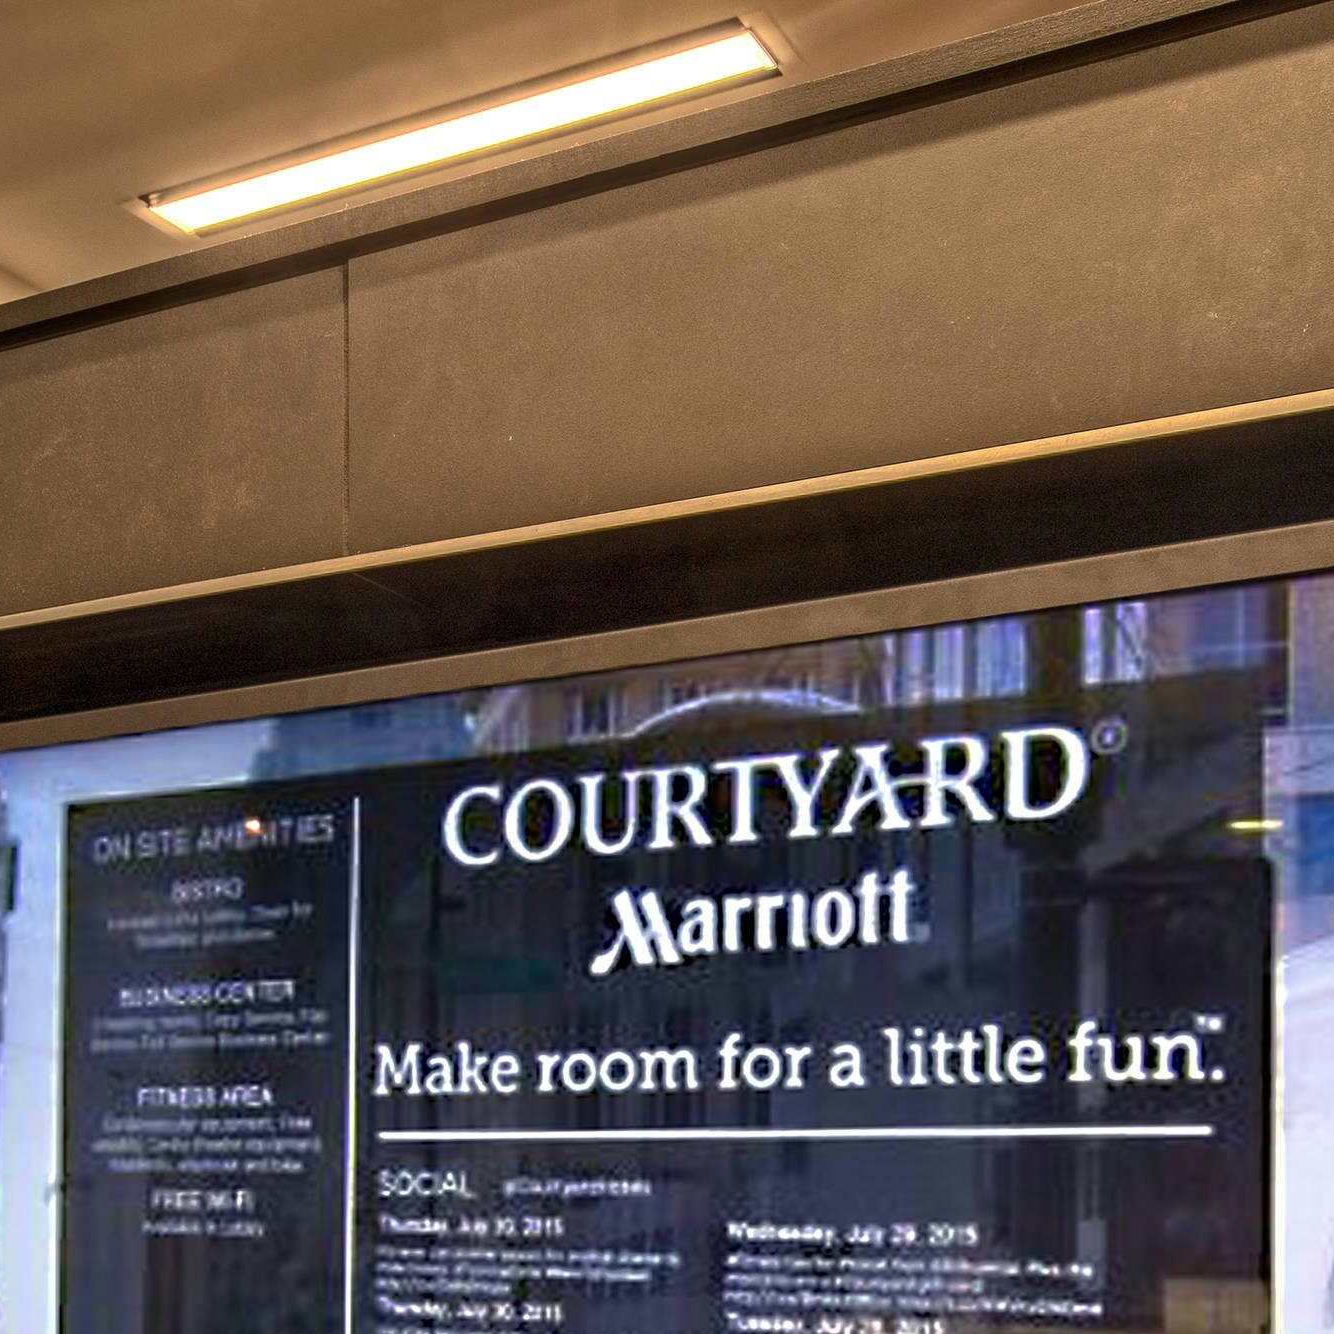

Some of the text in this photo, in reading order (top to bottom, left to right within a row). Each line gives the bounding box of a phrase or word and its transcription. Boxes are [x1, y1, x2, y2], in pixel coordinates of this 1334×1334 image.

[93, 831, 131, 865] ON
[136, 825, 189, 858] SITE
[590, 868, 917, 976] Marriott
[373, 1042, 518, 1096] Make
[537, 1044, 698, 1092] room
[718, 1031, 812, 1089] for
[829, 1041, 866, 1086] a
[884, 1023, 1046, 1084] little
[378, 1170, 474, 1197] SOCIAL
